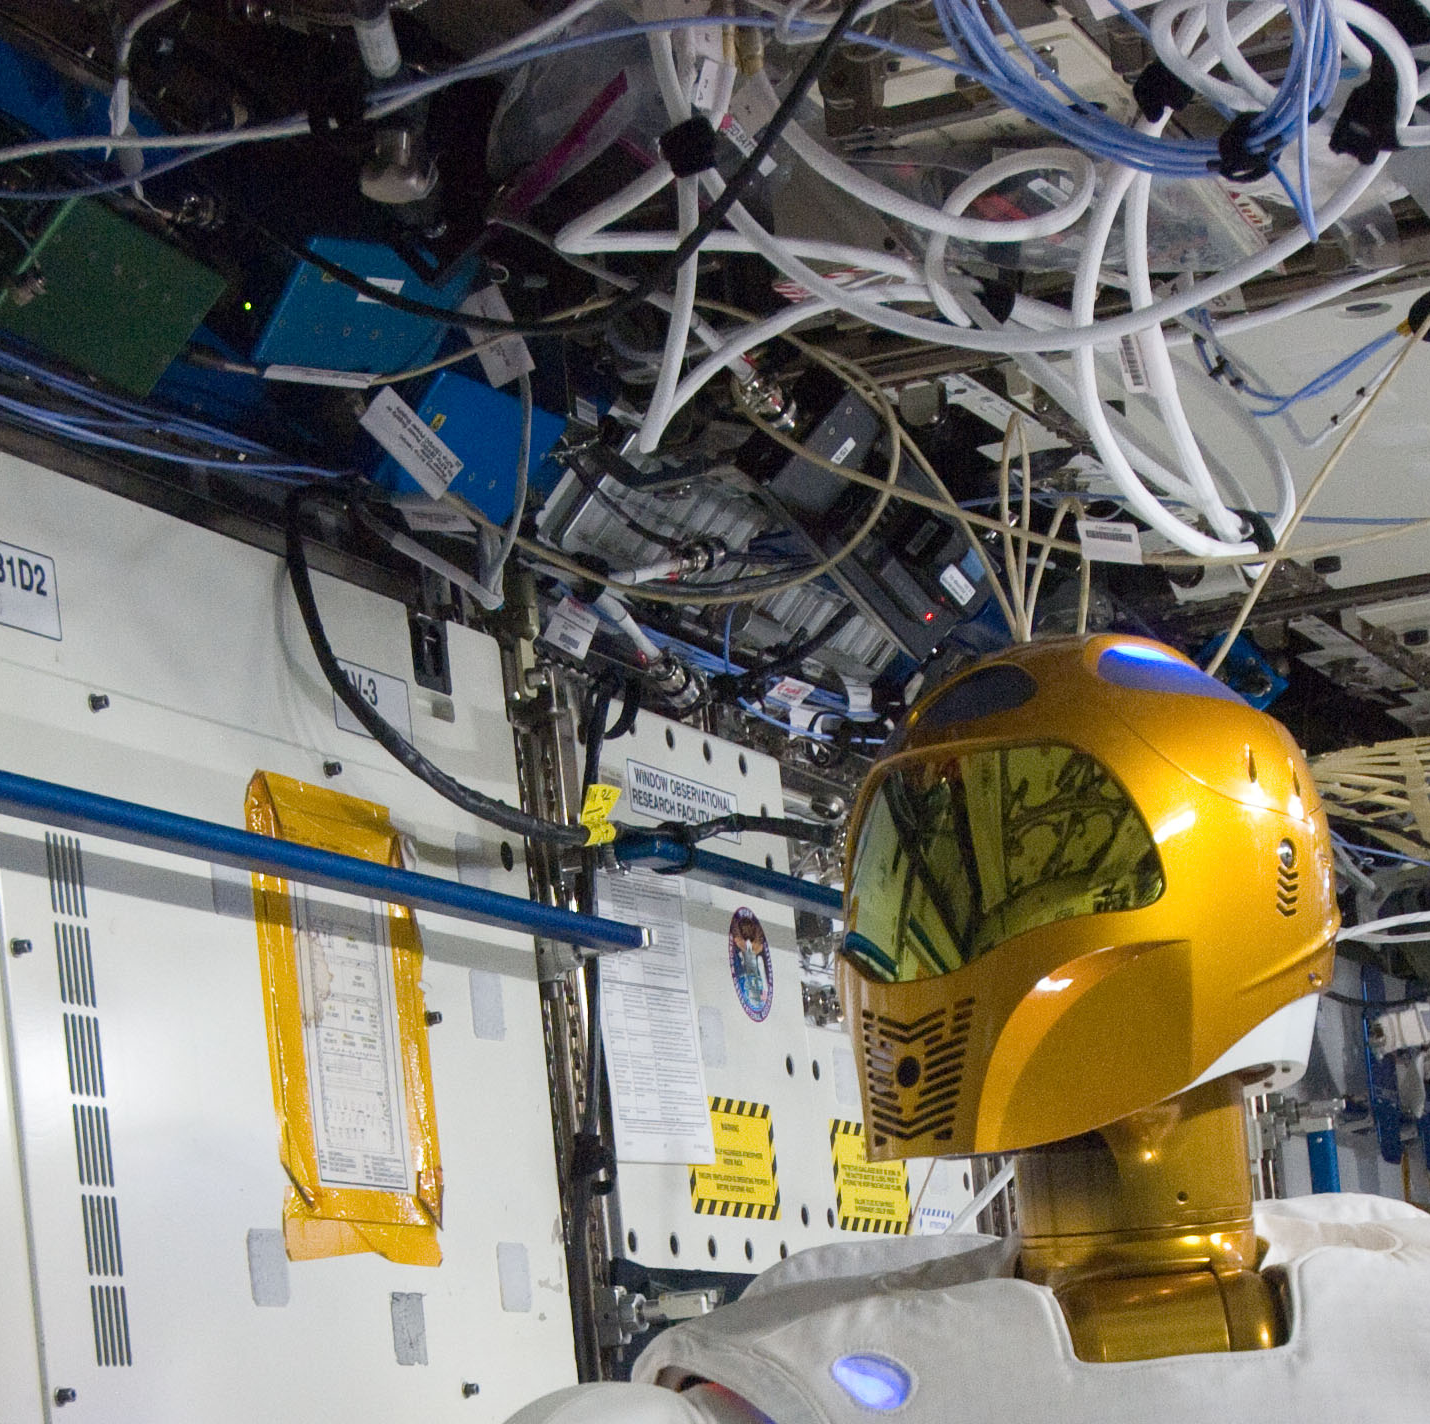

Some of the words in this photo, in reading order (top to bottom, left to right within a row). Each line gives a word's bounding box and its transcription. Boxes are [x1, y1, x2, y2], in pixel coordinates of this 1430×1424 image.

[632, 788, 675, 817] RESEARCH
[677, 802, 710, 825] FACILITY
[634, 767, 668, 793] WINDOW
[669, 779, 733, 813] OBSERVATIONAL
